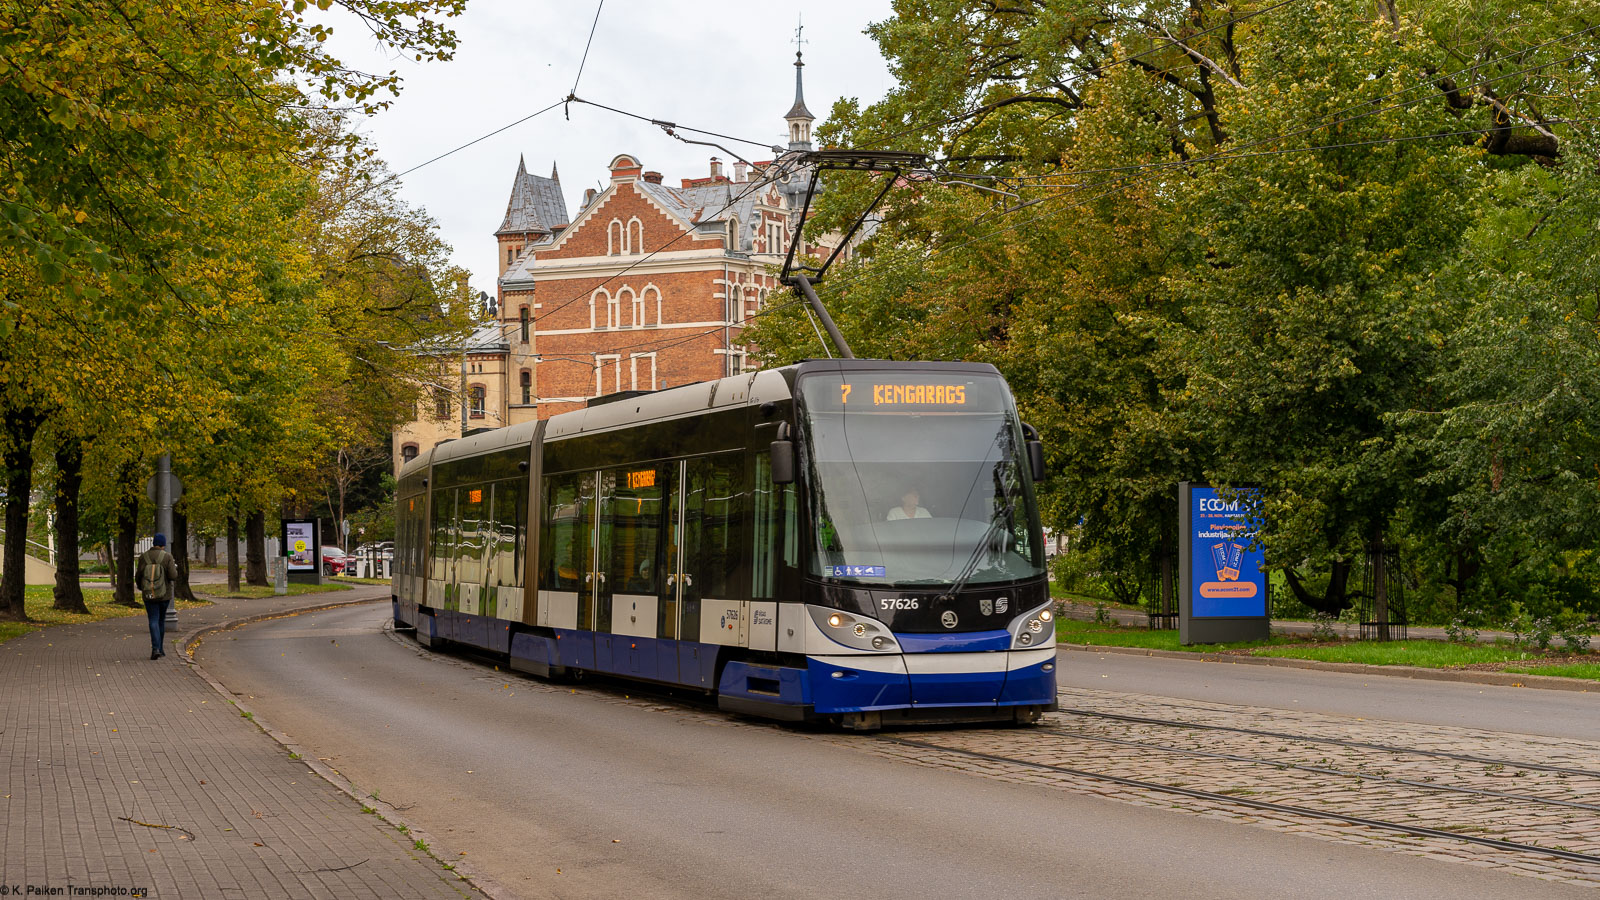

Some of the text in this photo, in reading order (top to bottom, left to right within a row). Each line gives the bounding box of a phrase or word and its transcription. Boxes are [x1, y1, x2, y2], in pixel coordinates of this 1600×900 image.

[840, 384, 966, 406] 7 ĶENGARAGS
[881, 599, 919, 610] 57626
